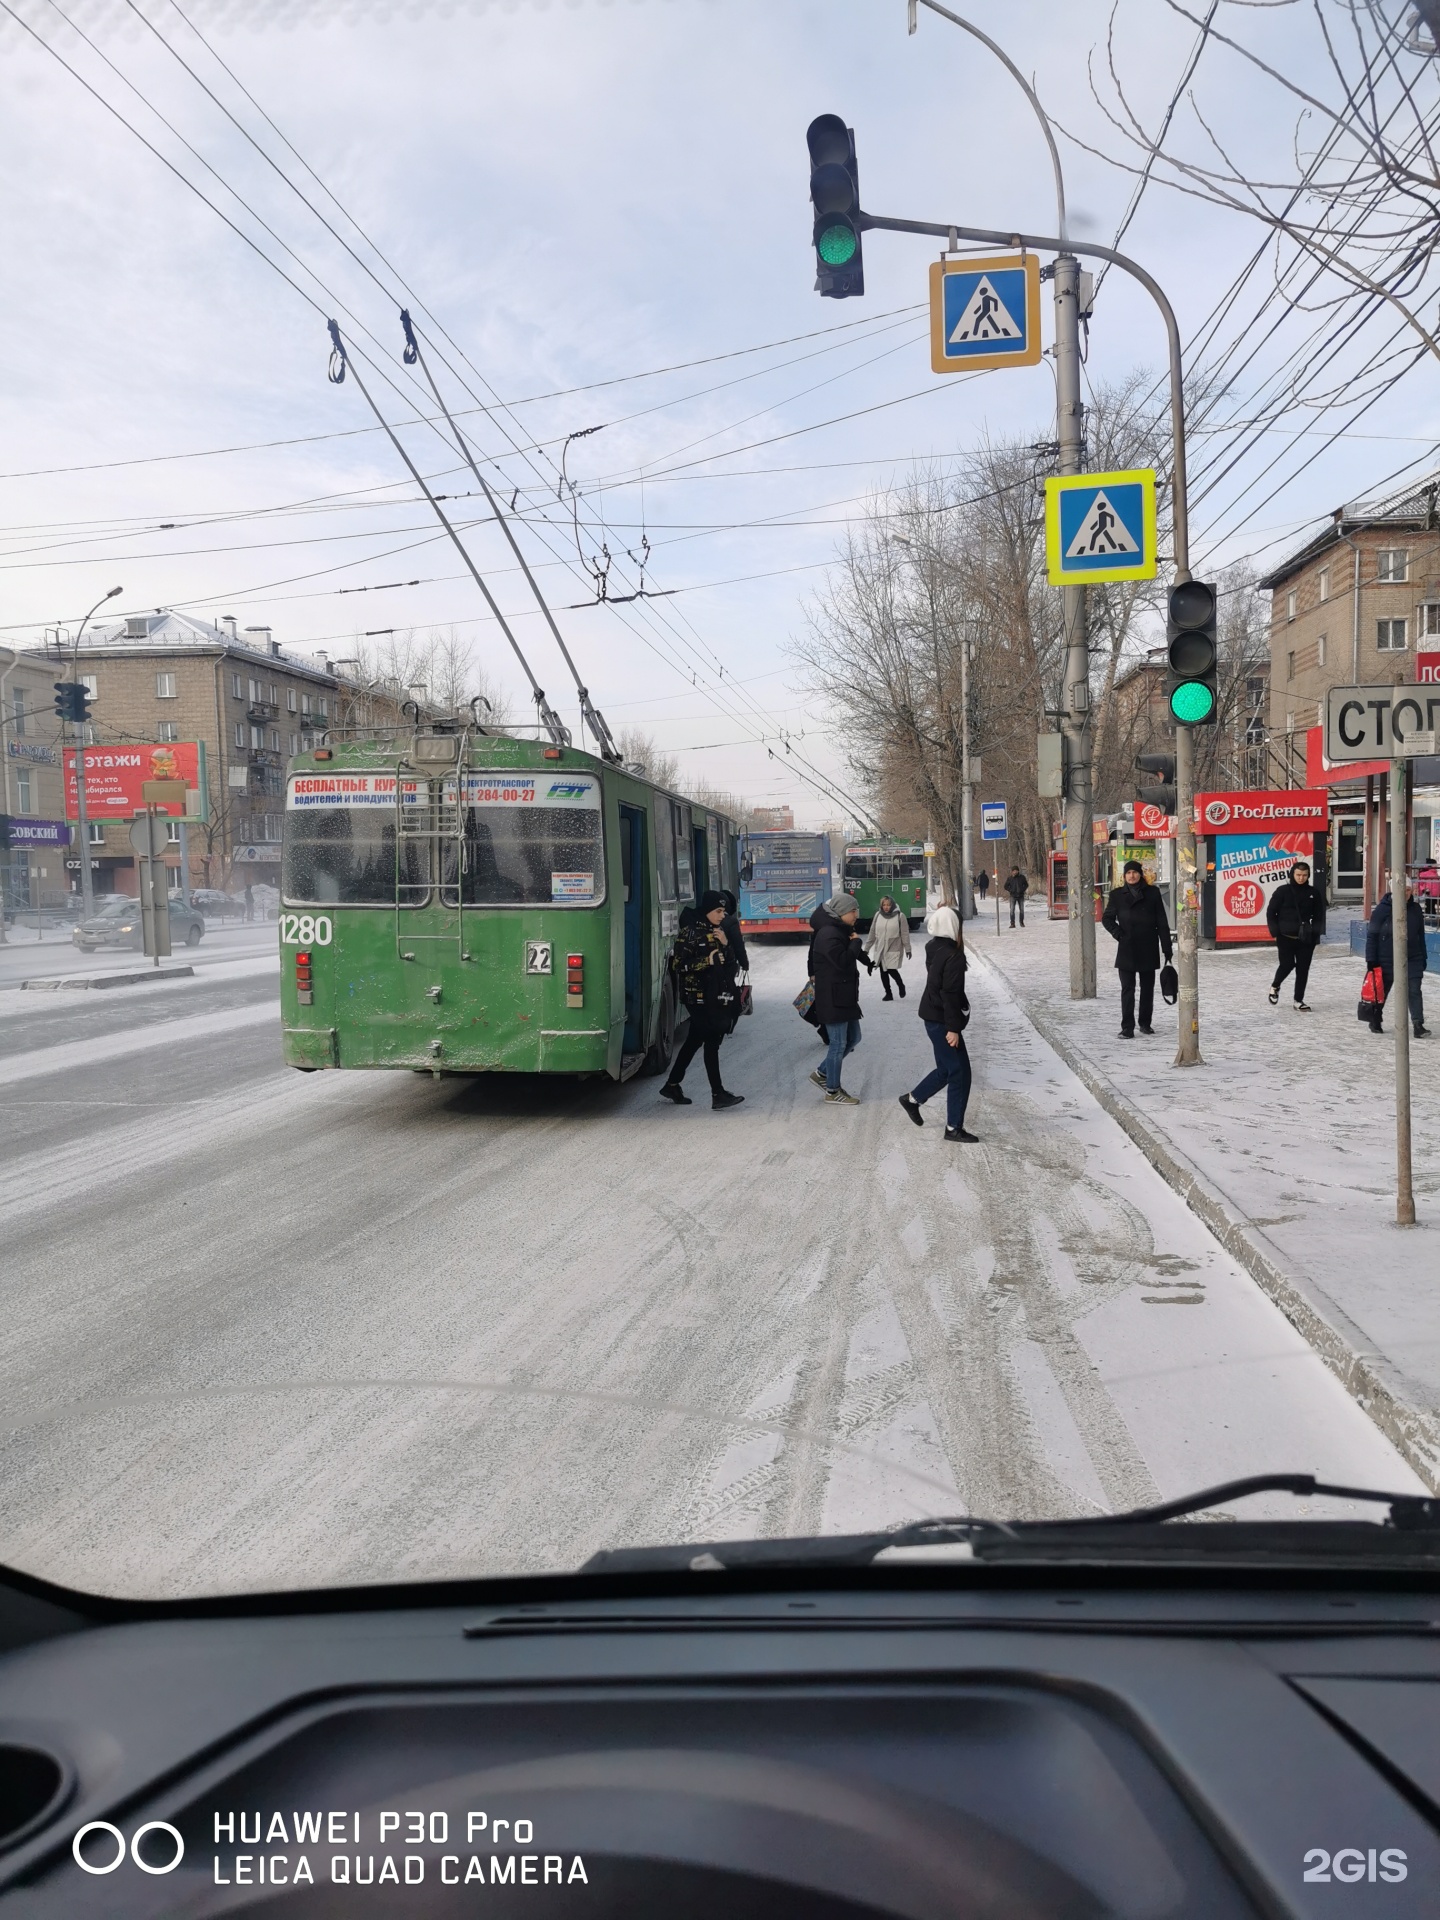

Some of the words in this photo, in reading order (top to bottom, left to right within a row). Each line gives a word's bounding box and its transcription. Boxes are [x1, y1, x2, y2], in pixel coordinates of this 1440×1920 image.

[85, 755, 141, 768] этажи
[104, 776, 119, 784] кто
[295, 779, 368, 793] БЕСПЛАТНЫЕ
[374, 778, 417, 792] КУРЫ
[477, 789, 535, 801] 284-00-27
[1233, 803, 1323, 820] РосДеньги
[1139, 829, 1170, 837] ЗАЙМЫ
[1221, 846, 1268, 869] ДЕНЬГИ
[66, 860, 100, 869] OZN
[1222, 869, 1236, 880] ПО
[844, 880, 862, 889] 1282
[1237, 885, 1257, 901] 30
[1231, 900, 1256, 908] ТЫСЯЧ
[279, 914, 332, 945] 1280
[528, 947, 550, 969] 22
